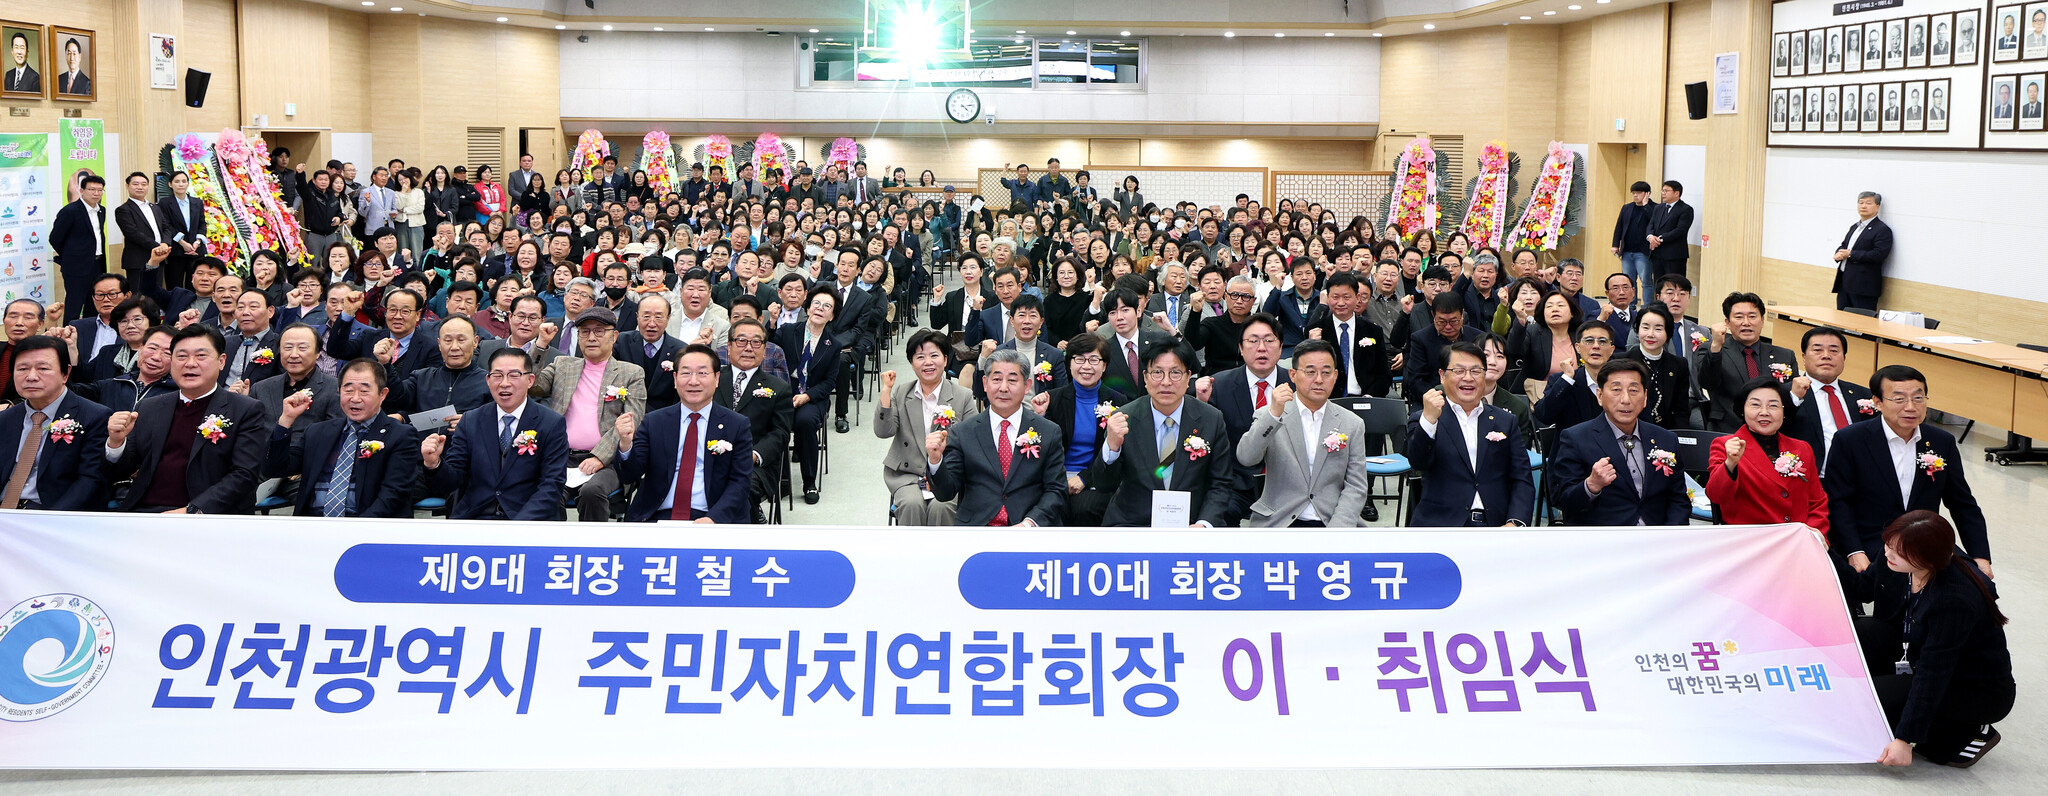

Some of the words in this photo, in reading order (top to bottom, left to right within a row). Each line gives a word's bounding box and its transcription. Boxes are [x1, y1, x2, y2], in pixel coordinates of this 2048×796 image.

[72, 127, 93, 138] 취임을
[76, 138, 90, 148] 축하
[70, 149, 97, 159] 드립니다
[419, 553, 525, 594] 제9대
[545, 555, 623, 596] 회장
[641, 556, 677, 595] 권
[696, 556, 732, 597] 철
[751, 557, 790, 597] 수
[1025, 560, 1149, 600] 제10대
[1169, 561, 1245, 601] 회장
[1264, 561, 1300, 601] 박
[1317, 561, 1351, 601] 영
[1371, 562, 1408, 600] 규
[152, 623, 541, 714] 인천광역시
[578, 630, 1184, 717] 주민자치연합회장
[1223, 632, 1290, 716] 이
[1376, 629, 1597, 714] 취임식
[1635, 653, 1689, 673] 인천의
[1690, 642, 1720, 671] 꿈
[83, 664, 104, 689] COMMITTEE
[1667, 673, 1762, 695] 대한민국의
[1764, 664, 1831, 692] 미래
